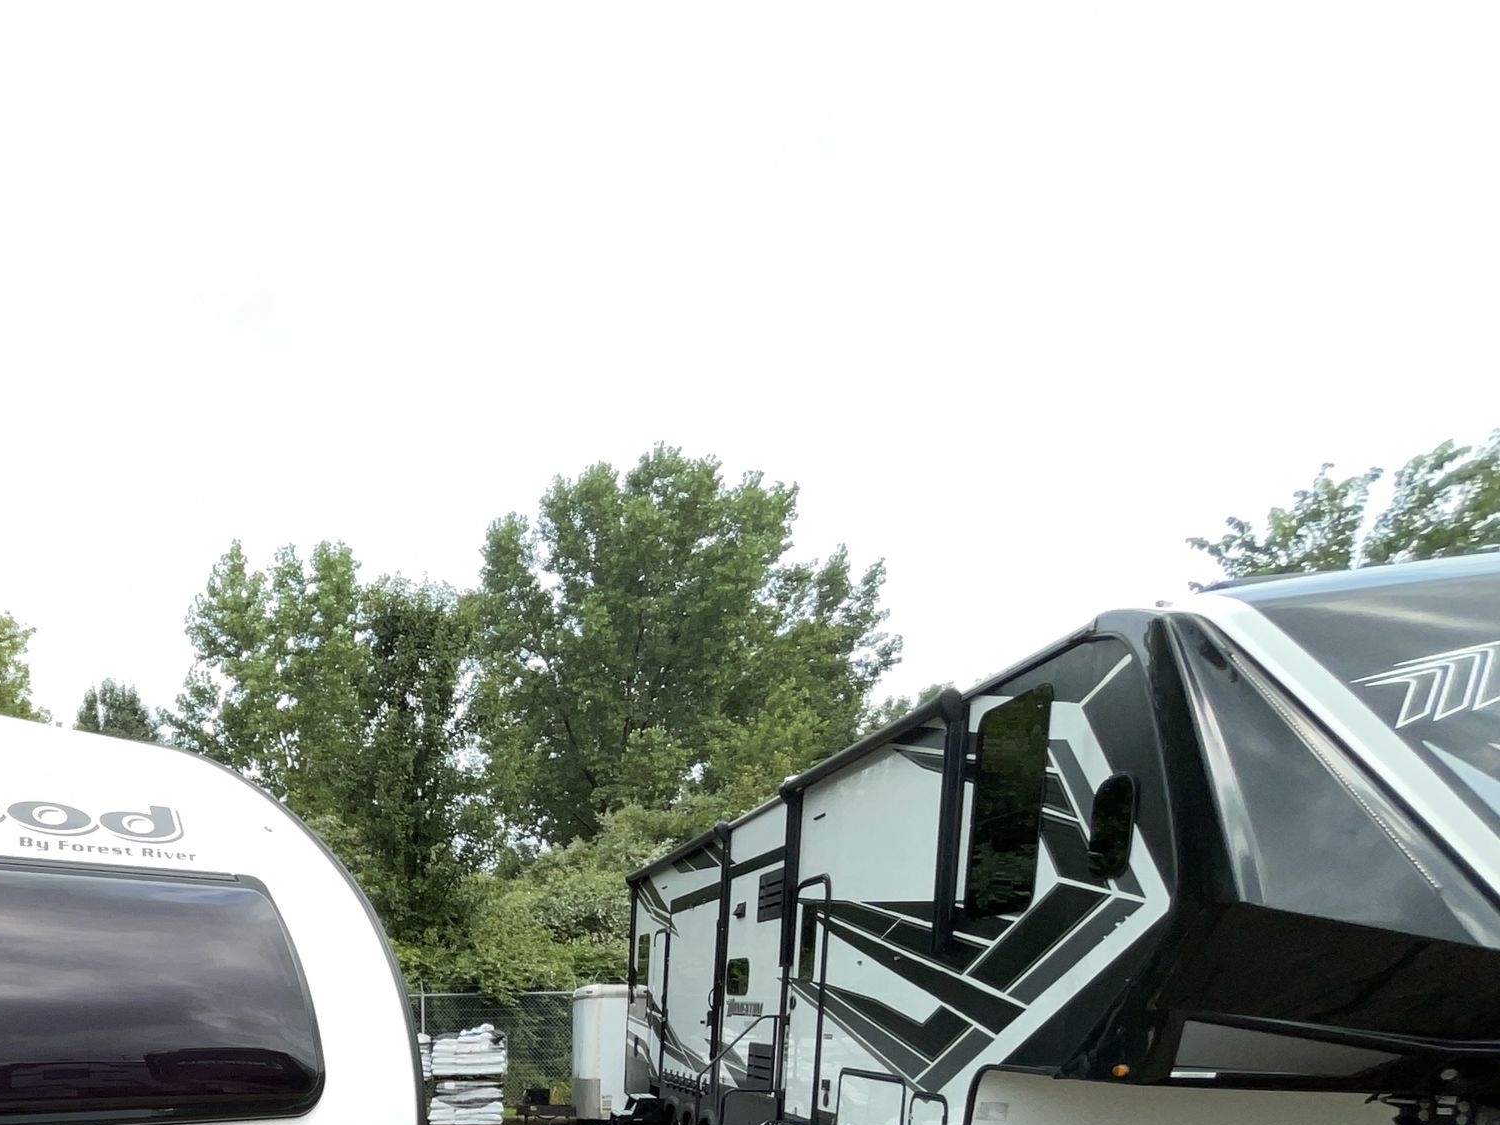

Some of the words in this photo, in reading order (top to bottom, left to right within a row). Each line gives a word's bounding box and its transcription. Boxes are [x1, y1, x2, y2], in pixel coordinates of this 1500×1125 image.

[19, 836, 49, 851] By
[58, 840, 134, 857] Forest
[142, 847, 197, 861] River
